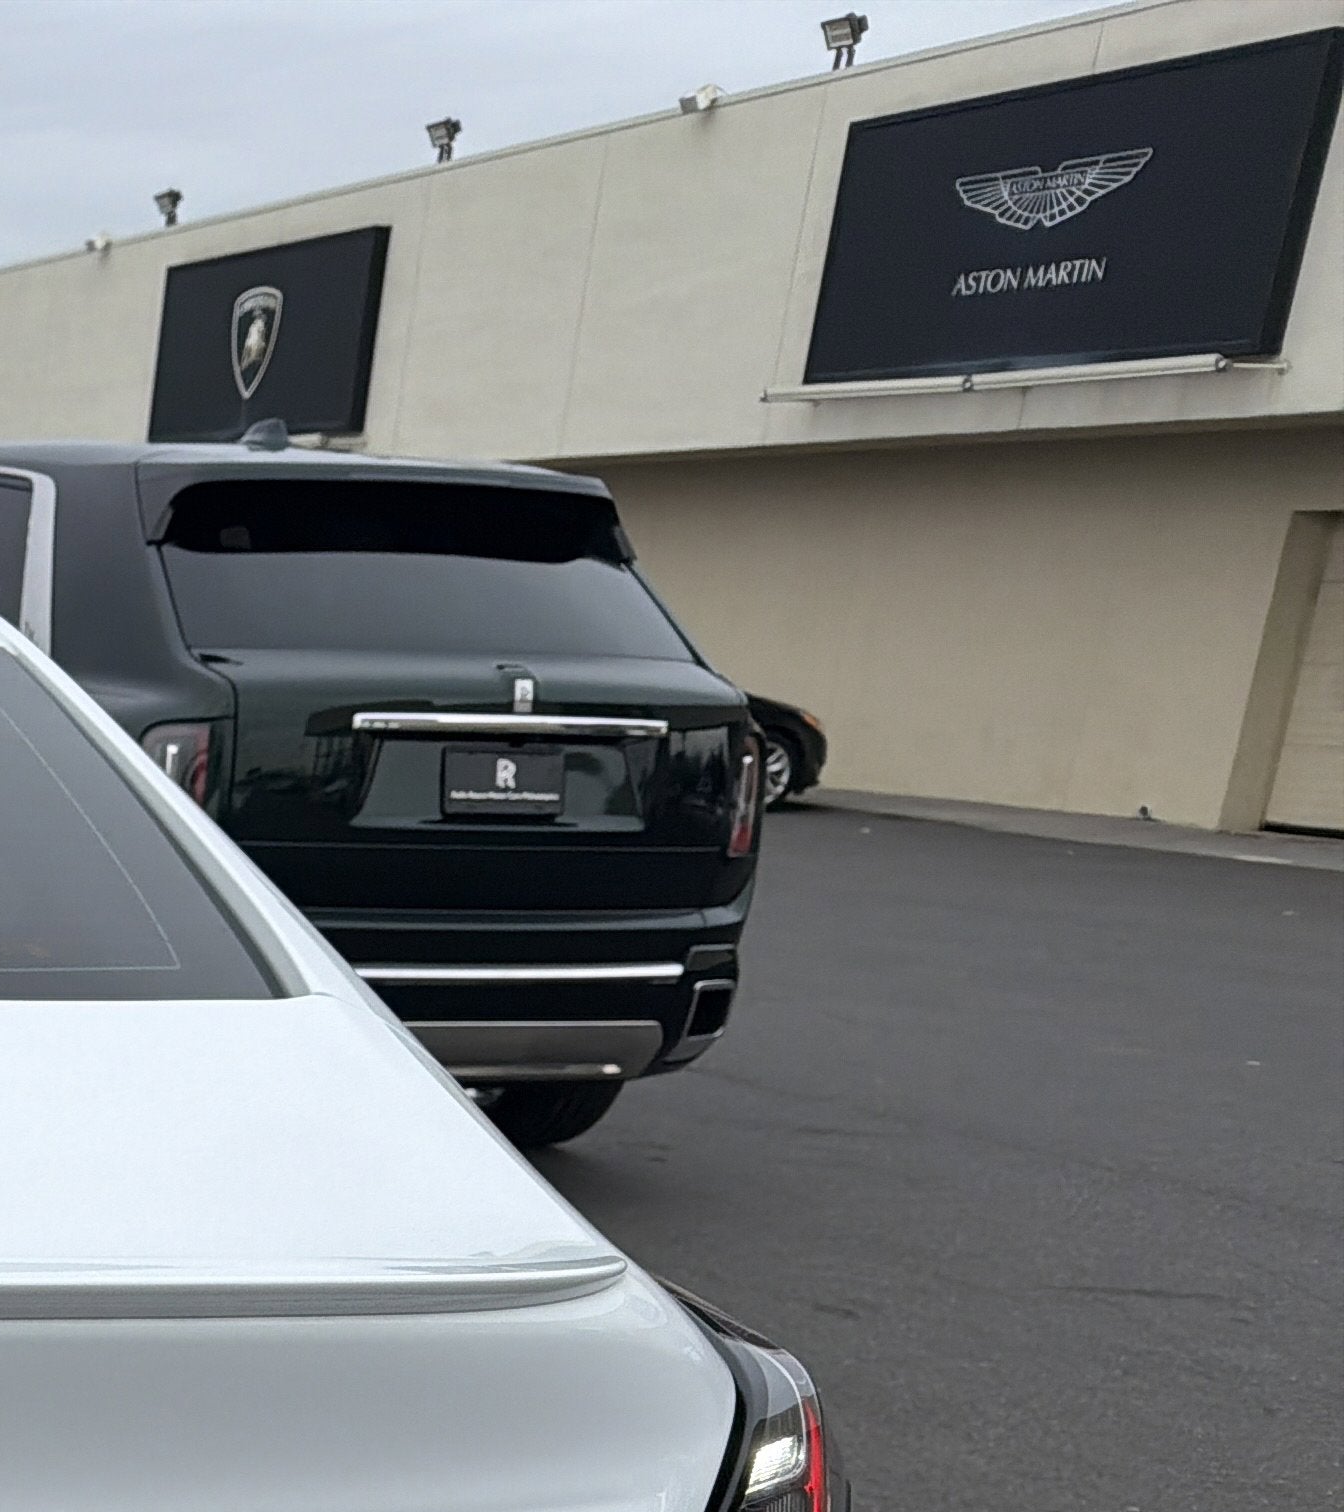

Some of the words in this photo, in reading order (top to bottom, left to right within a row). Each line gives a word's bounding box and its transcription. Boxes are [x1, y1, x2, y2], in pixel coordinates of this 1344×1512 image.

[1012, 177, 1045, 195] ASTON
[1045, 171, 1087, 189] MARTIN
[951, 268, 1022, 297] ASTON
[1023, 257, 1107, 290] MARTIN
